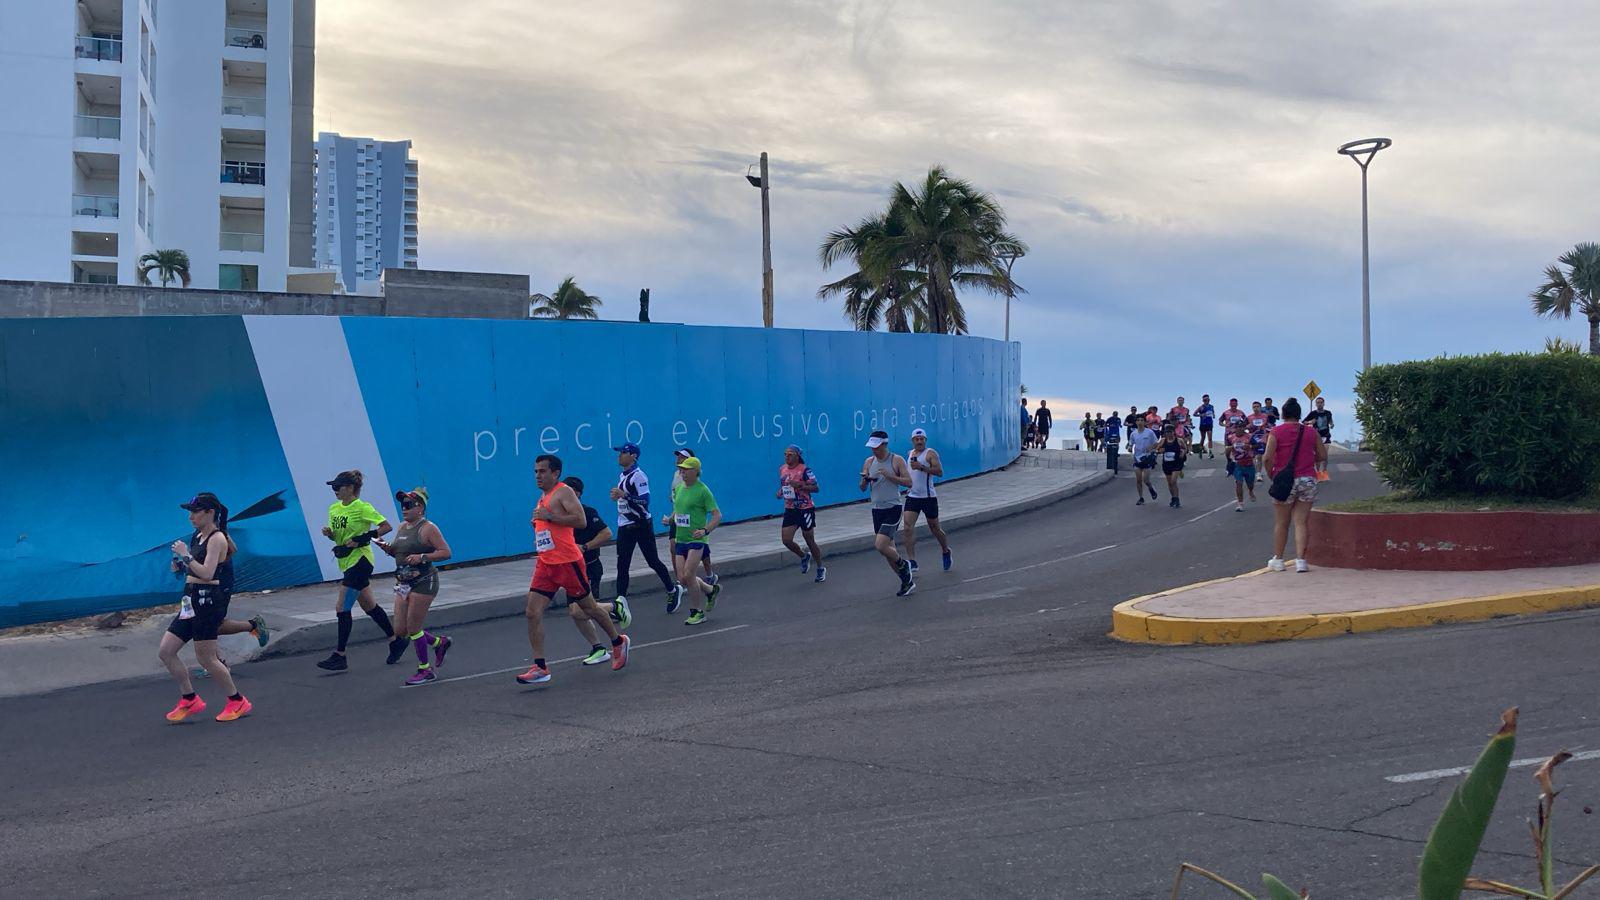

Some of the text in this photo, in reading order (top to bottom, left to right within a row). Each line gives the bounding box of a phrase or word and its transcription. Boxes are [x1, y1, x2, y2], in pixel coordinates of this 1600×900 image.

[474, 412, 644, 472] precio
[672, 405, 830, 446] exclusivo
[853, 407, 898, 439] para
